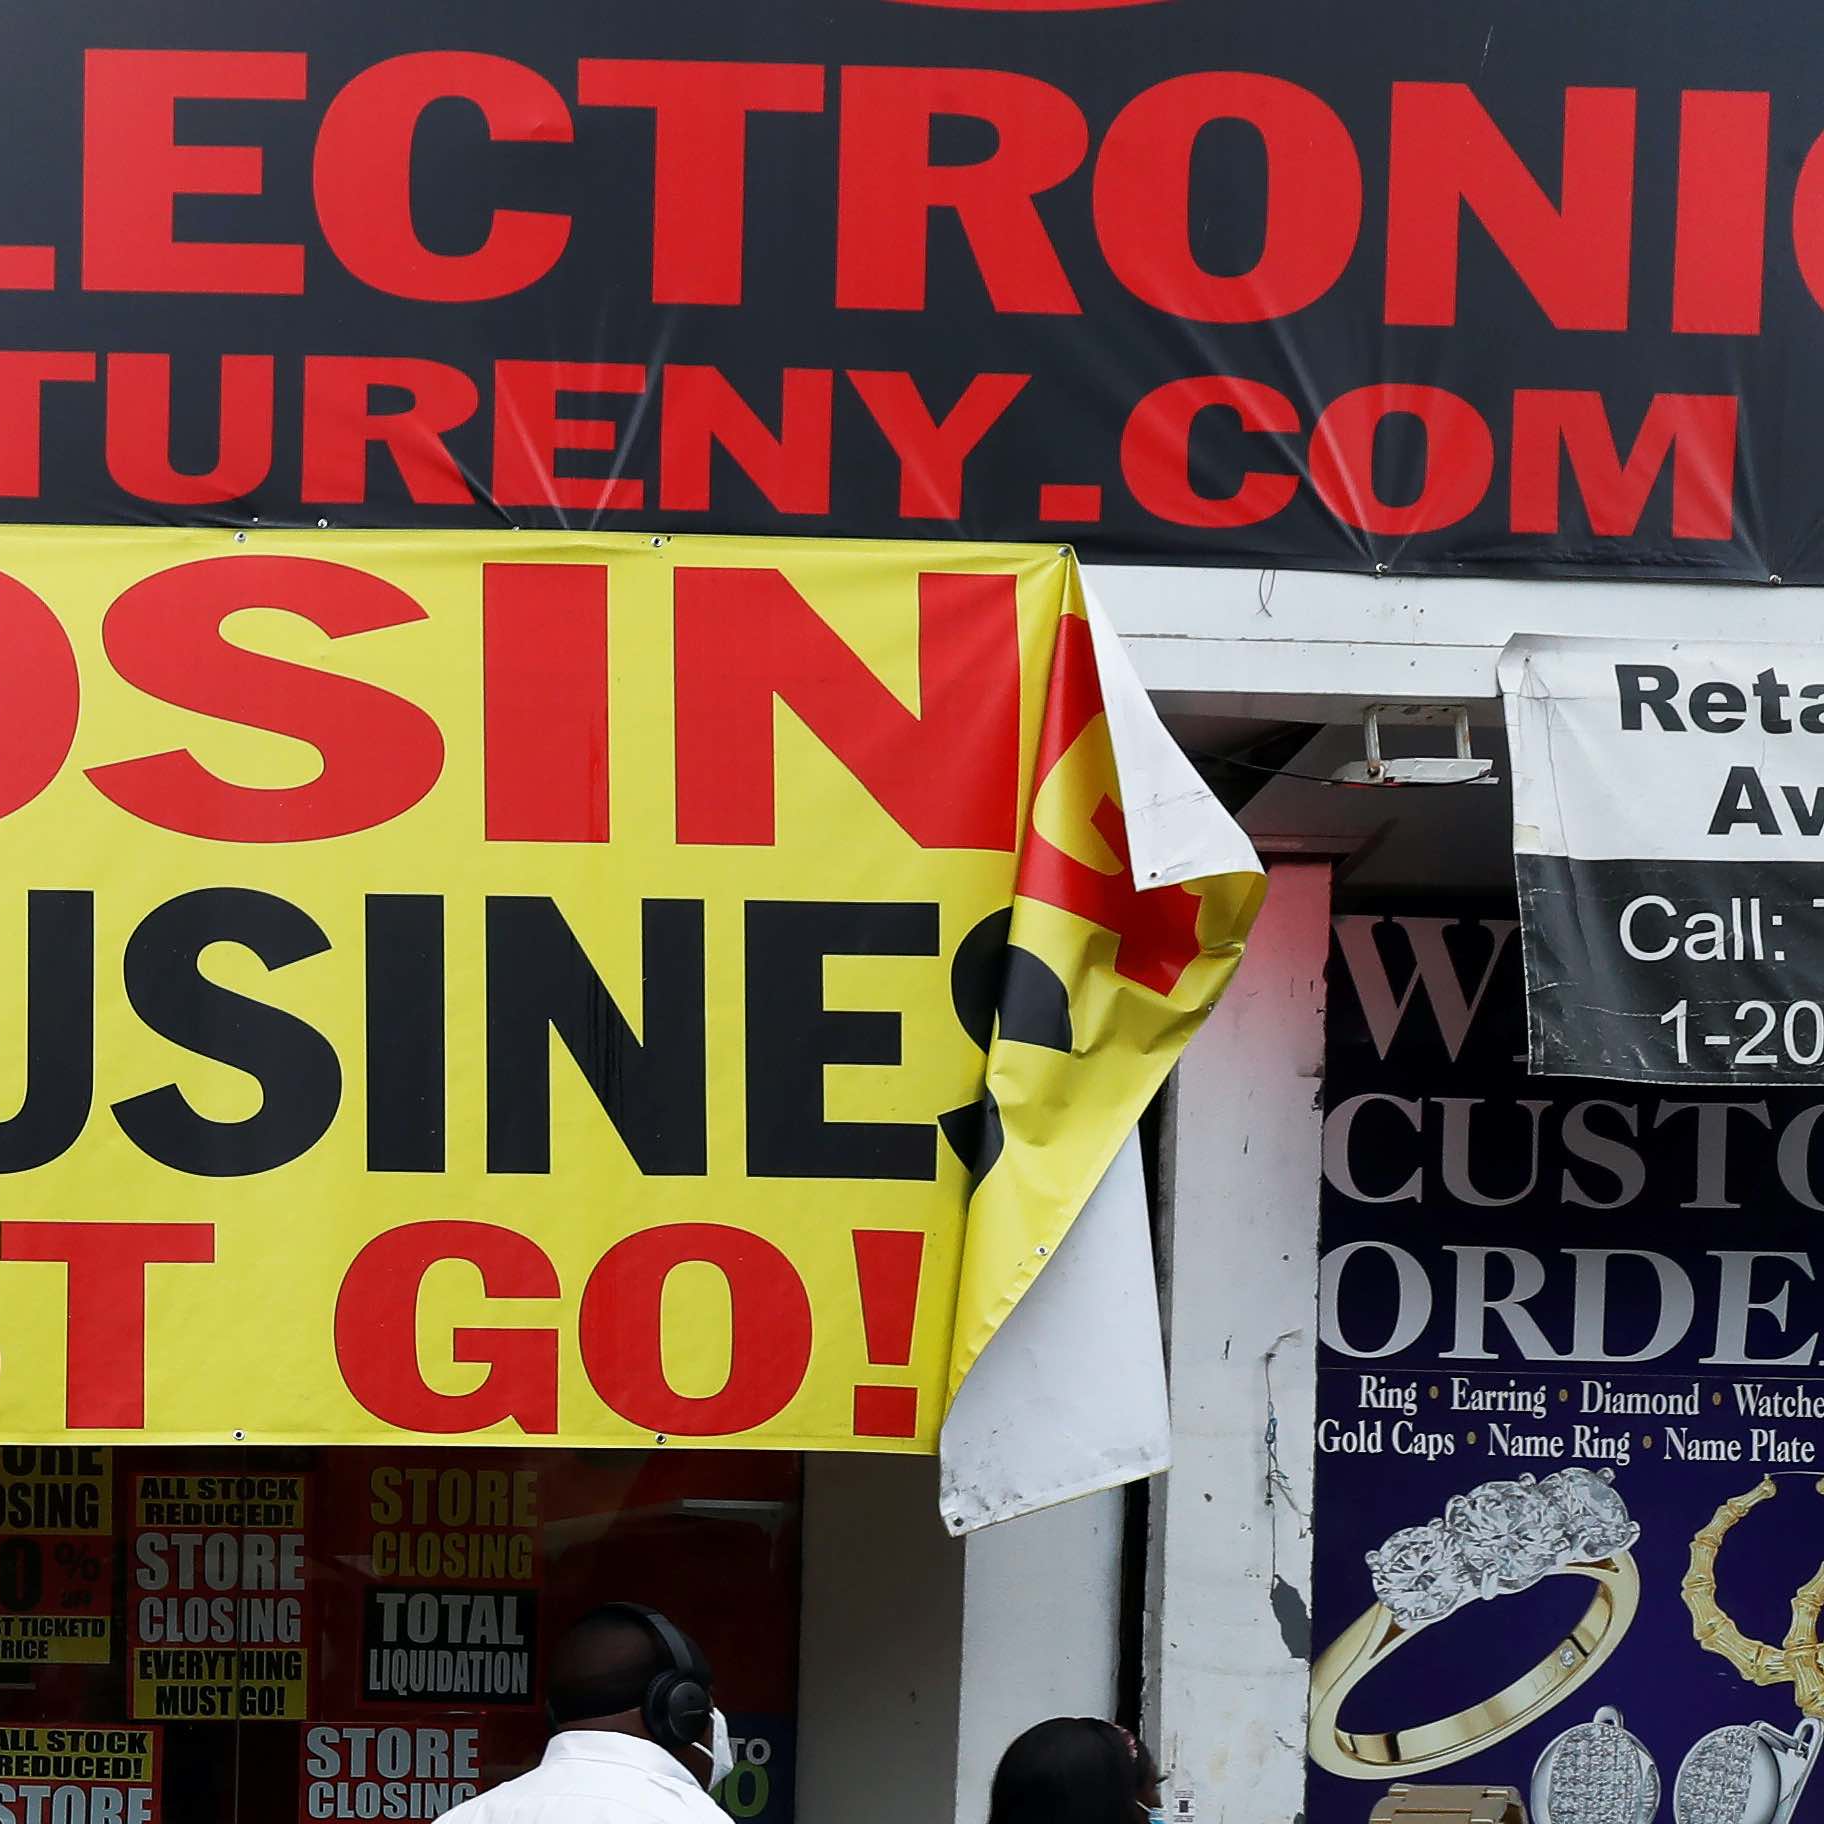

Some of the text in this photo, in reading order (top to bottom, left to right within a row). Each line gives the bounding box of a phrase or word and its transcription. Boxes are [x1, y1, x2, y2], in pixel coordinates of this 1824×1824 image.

[1619, 895, 1786, 962] Call:
[1319, 1241, 1824, 1367] ORDE
[334, 1220, 924, 1440] GO!
[1358, 1374, 1418, 1416] Ring
[1450, 1377, 1547, 1419] Earring
[1579, 1380, 1700, 1416] Diamond
[1318, 1419, 1816, 1466] Gold Caps Name Ring Name Plate
[140, 1478, 299, 1501] ALL STOCK
[369, 1467, 539, 1527] STORE
[143, 1503, 295, 1528] REDUCED!
[135, 1533, 306, 1592] STORE
[370, 1531, 533, 1580] CLOSING
[19, 1617, 106, 1639] TICKETD
[138, 1597, 301, 1644] CLOSING
[376, 1592, 524, 1645] TOTAL
[139, 1650, 302, 1682] EVERYTHING
[369, 1649, 529, 1695] LIQUIDATION
[155, 1685, 285, 1718] MUST GO!
[46, 1730, 148, 1755] STOCK
[306, 1726, 480, 1779] STORE
